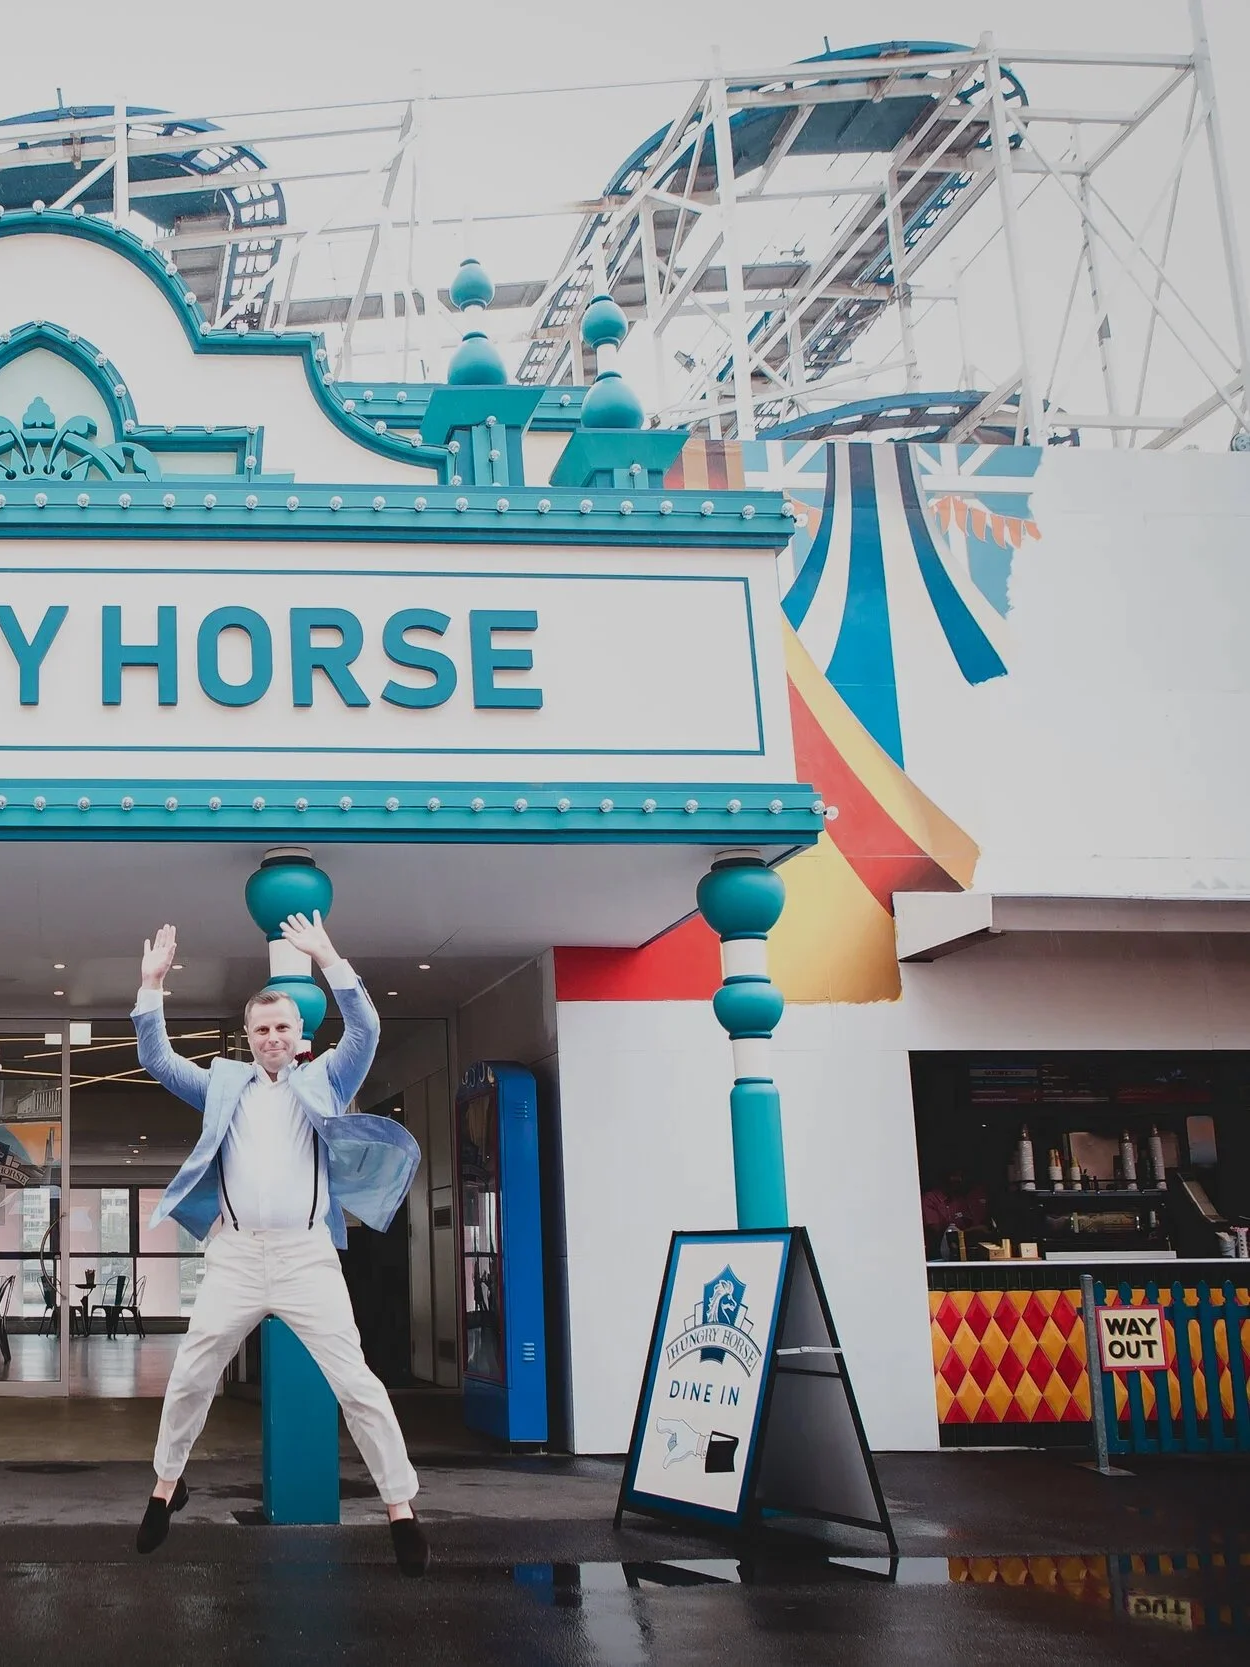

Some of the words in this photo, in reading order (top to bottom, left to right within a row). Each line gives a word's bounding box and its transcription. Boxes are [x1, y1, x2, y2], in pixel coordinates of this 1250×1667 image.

[102, 605, 544, 710] HORSE
[1104, 1317, 1157, 1336] WAY
[670, 1327, 719, 1359] HUNGRY
[722, 1329, 757, 1367] HORSE
[1108, 1340, 1157, 1359] OUT
[669, 1380, 713, 1403] DINE
[720, 1385, 740, 1406] IN
